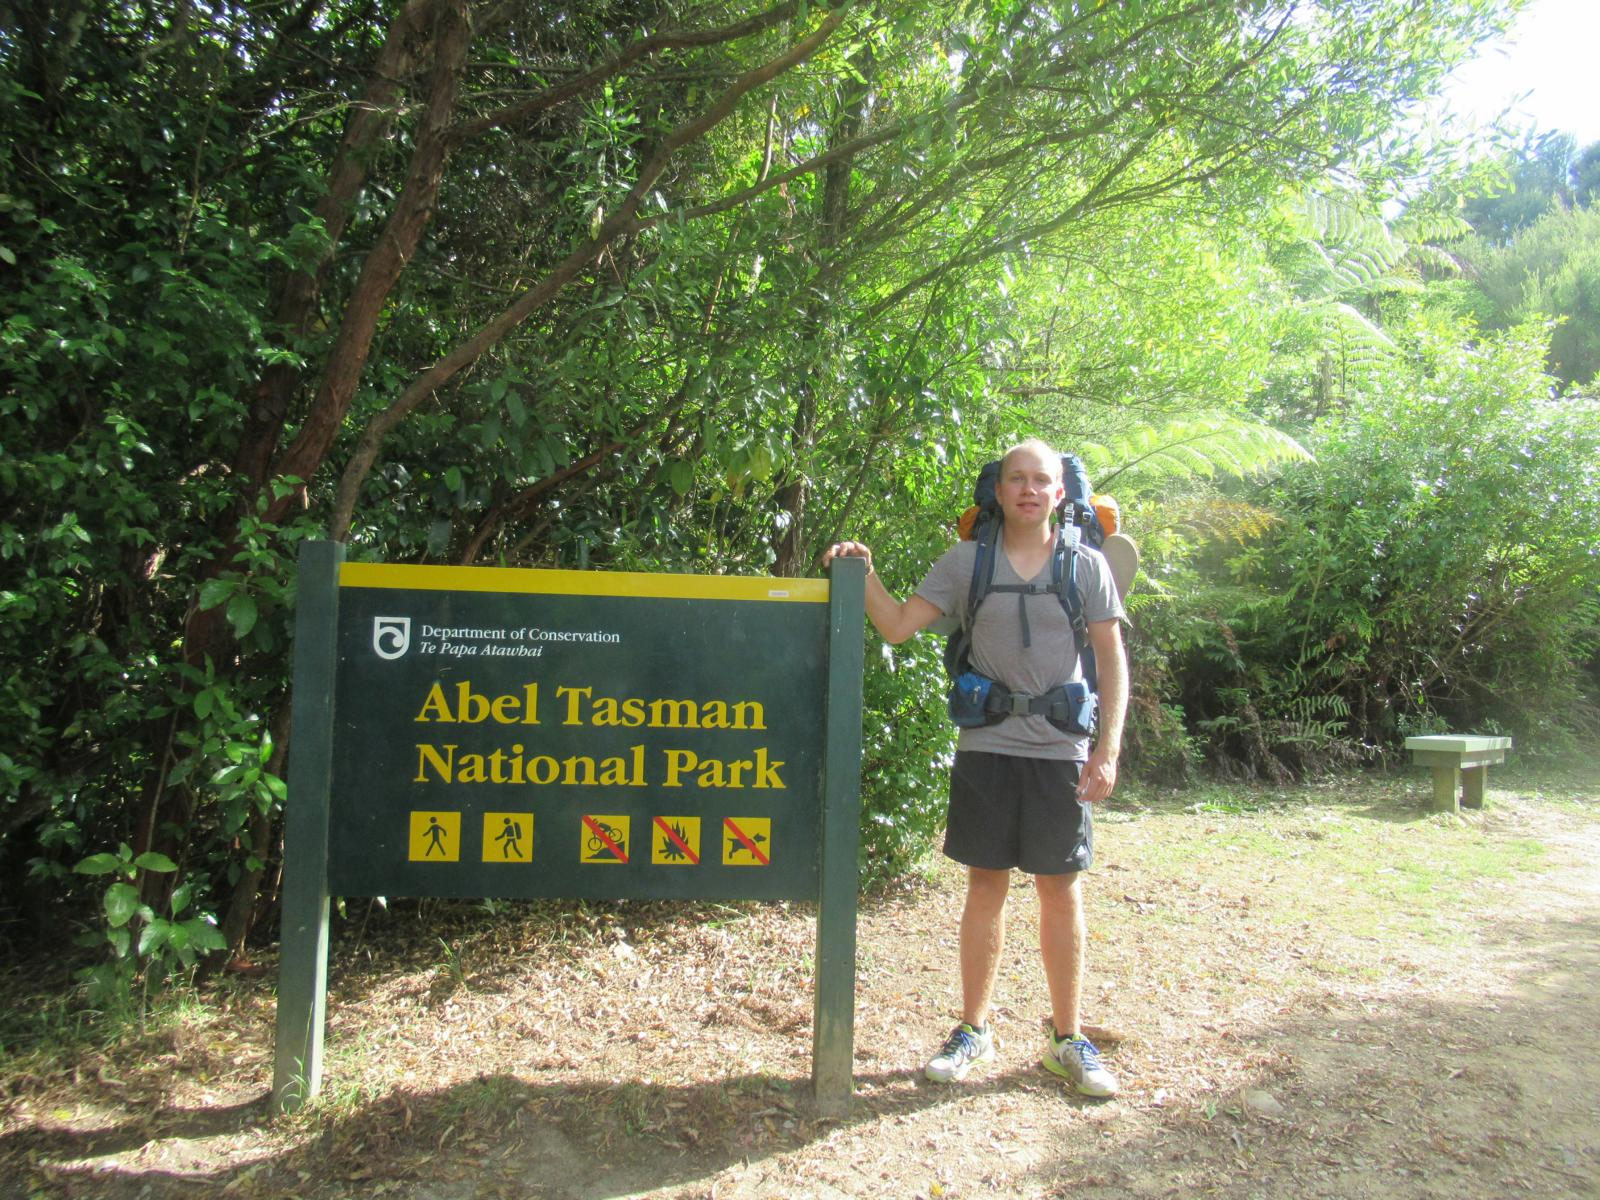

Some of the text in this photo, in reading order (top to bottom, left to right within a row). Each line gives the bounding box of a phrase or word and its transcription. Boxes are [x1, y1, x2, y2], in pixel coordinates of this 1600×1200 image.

[419, 641, 437, 654] Te
[439, 642, 477, 658] Papa
[421, 624, 621, 643] Department of Conservation
[414, 681, 768, 730] Abel Tasman
[414, 744, 787, 789] National Park
